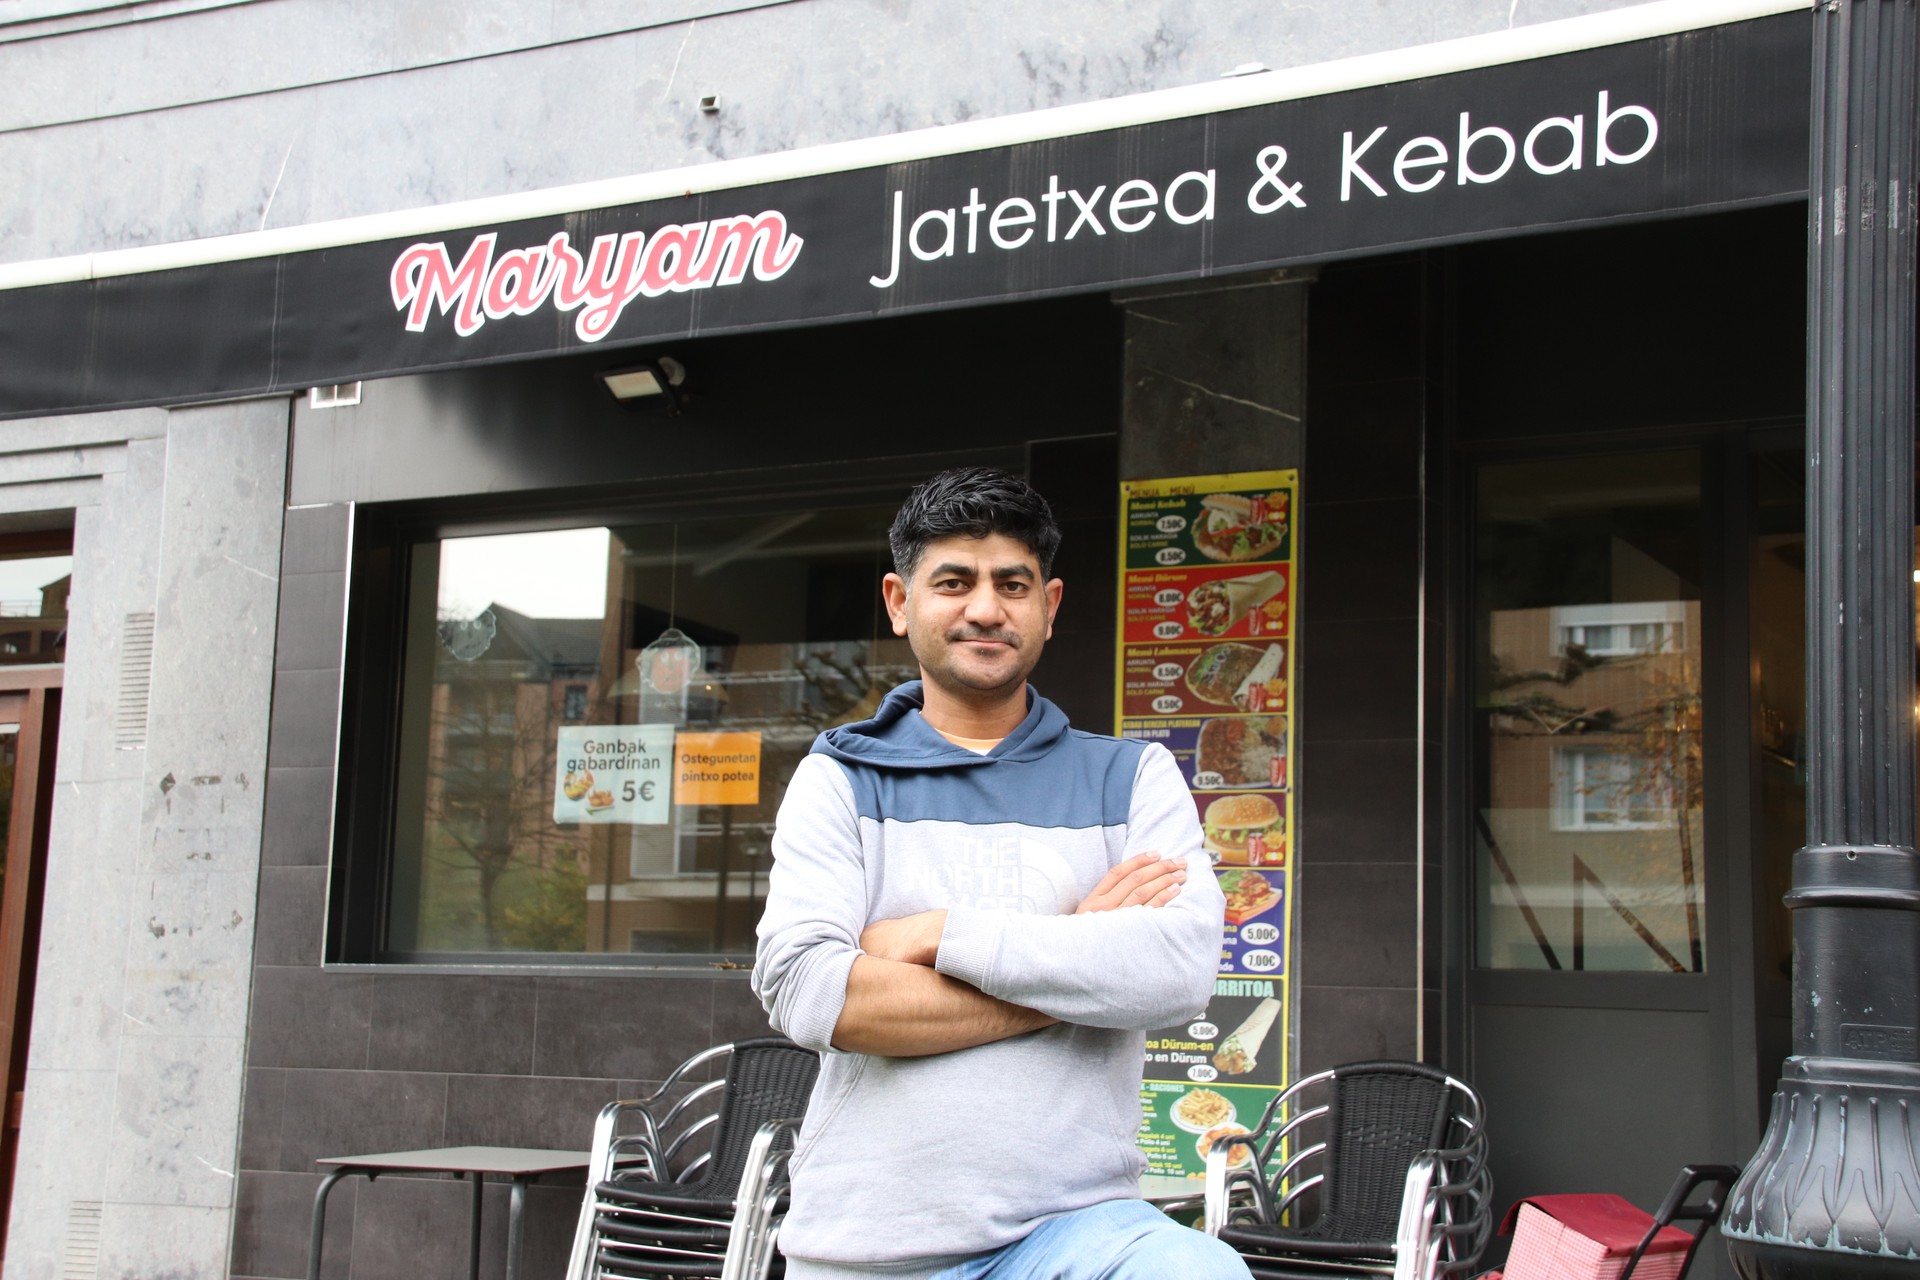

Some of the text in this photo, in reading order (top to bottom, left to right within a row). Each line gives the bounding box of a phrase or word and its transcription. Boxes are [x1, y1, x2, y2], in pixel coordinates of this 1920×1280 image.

[391, 90, 1659, 342] Maryam Jatetxea & Kebab
[584, 738, 646, 754] Ganbak
[566, 754, 660, 772] gabardinan
[681, 754, 756, 766] Ostegunetan
[682, 771, 754, 784] pintxo potea
[622, 780, 656, 802] 5€
[959, 837, 1018, 866] THE
[908, 863, 1018, 896] NORTH
[1211, 979, 1274, 998] RRITOA
